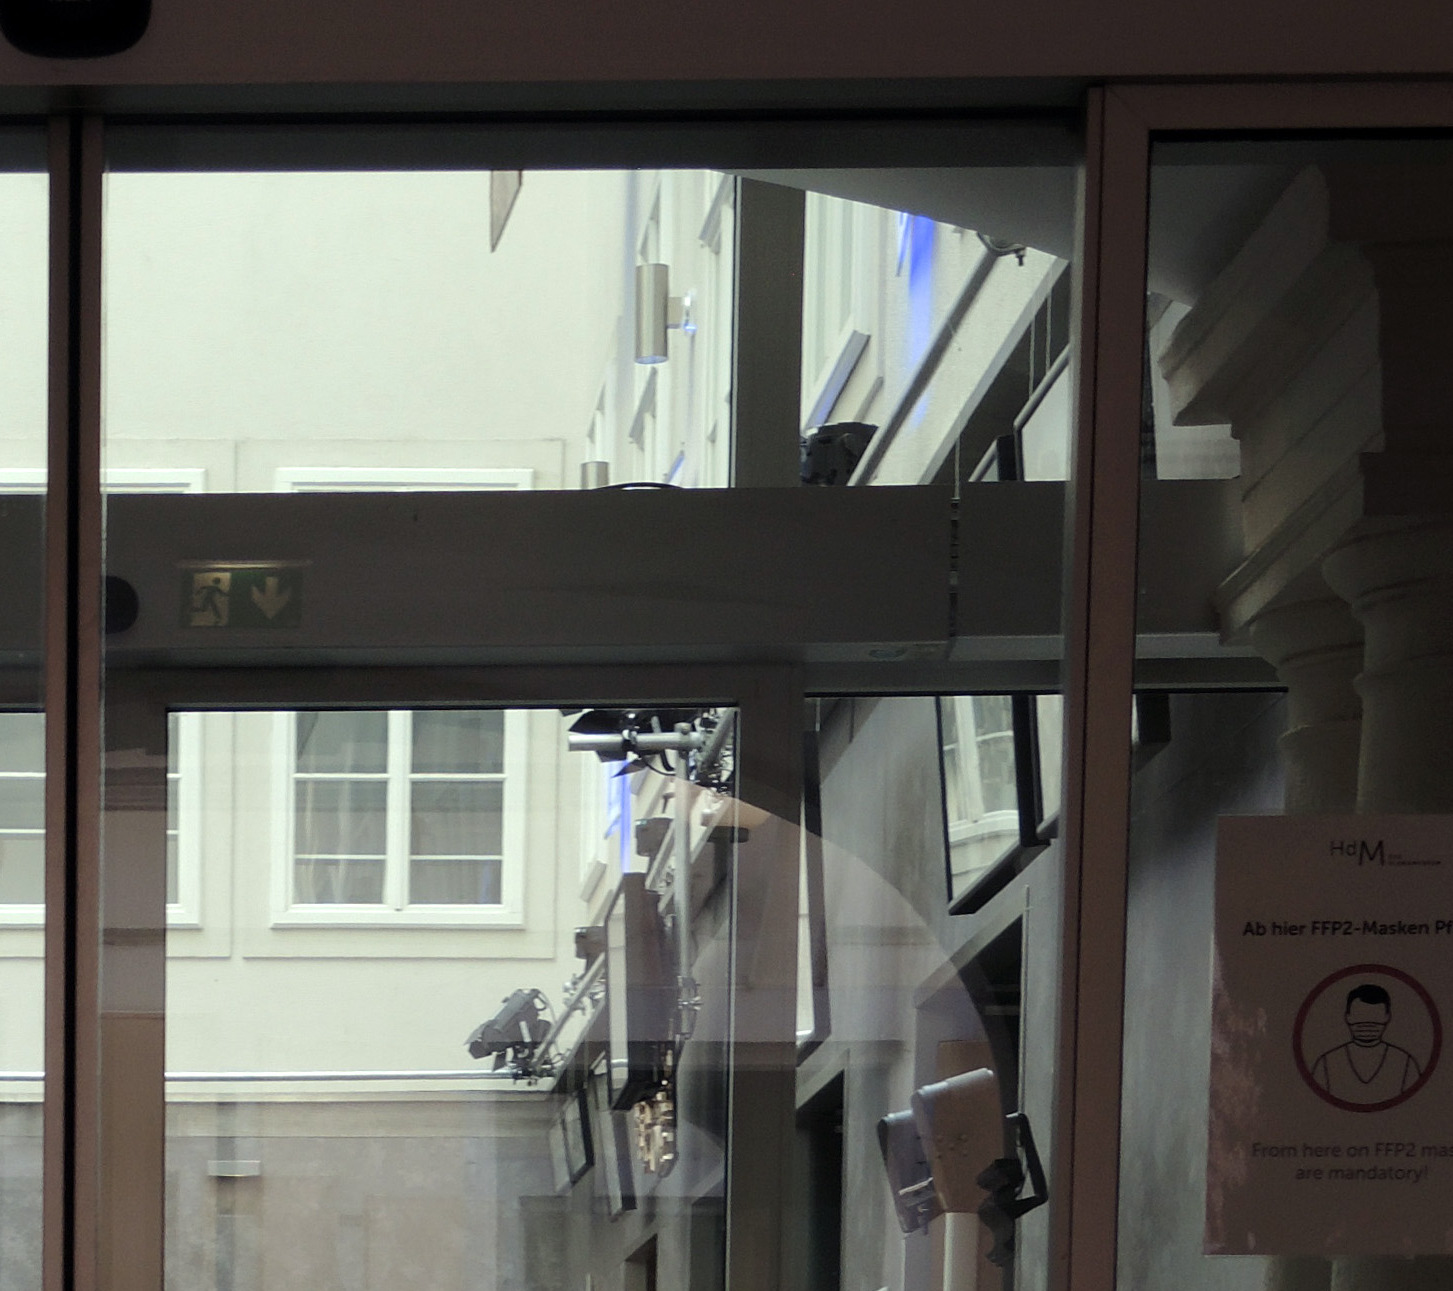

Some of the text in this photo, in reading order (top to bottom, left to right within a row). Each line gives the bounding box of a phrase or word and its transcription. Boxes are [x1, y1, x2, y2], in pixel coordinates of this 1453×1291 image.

[1330, 840, 1384, 866] HdM
[1242, 921, 1267, 936] Ab
[1272, 921, 1306, 936] hier
[1311, 920, 1429, 936] FFP2-Masken
[1252, 1142, 1297, 1157] From
[1303, 1142, 1341, 1157] here
[1347, 1145, 1369, 1157] on
[1375, 1142, 1416, 1157] FFP2
[1296, 1166, 1428, 1183] are mandatory!
